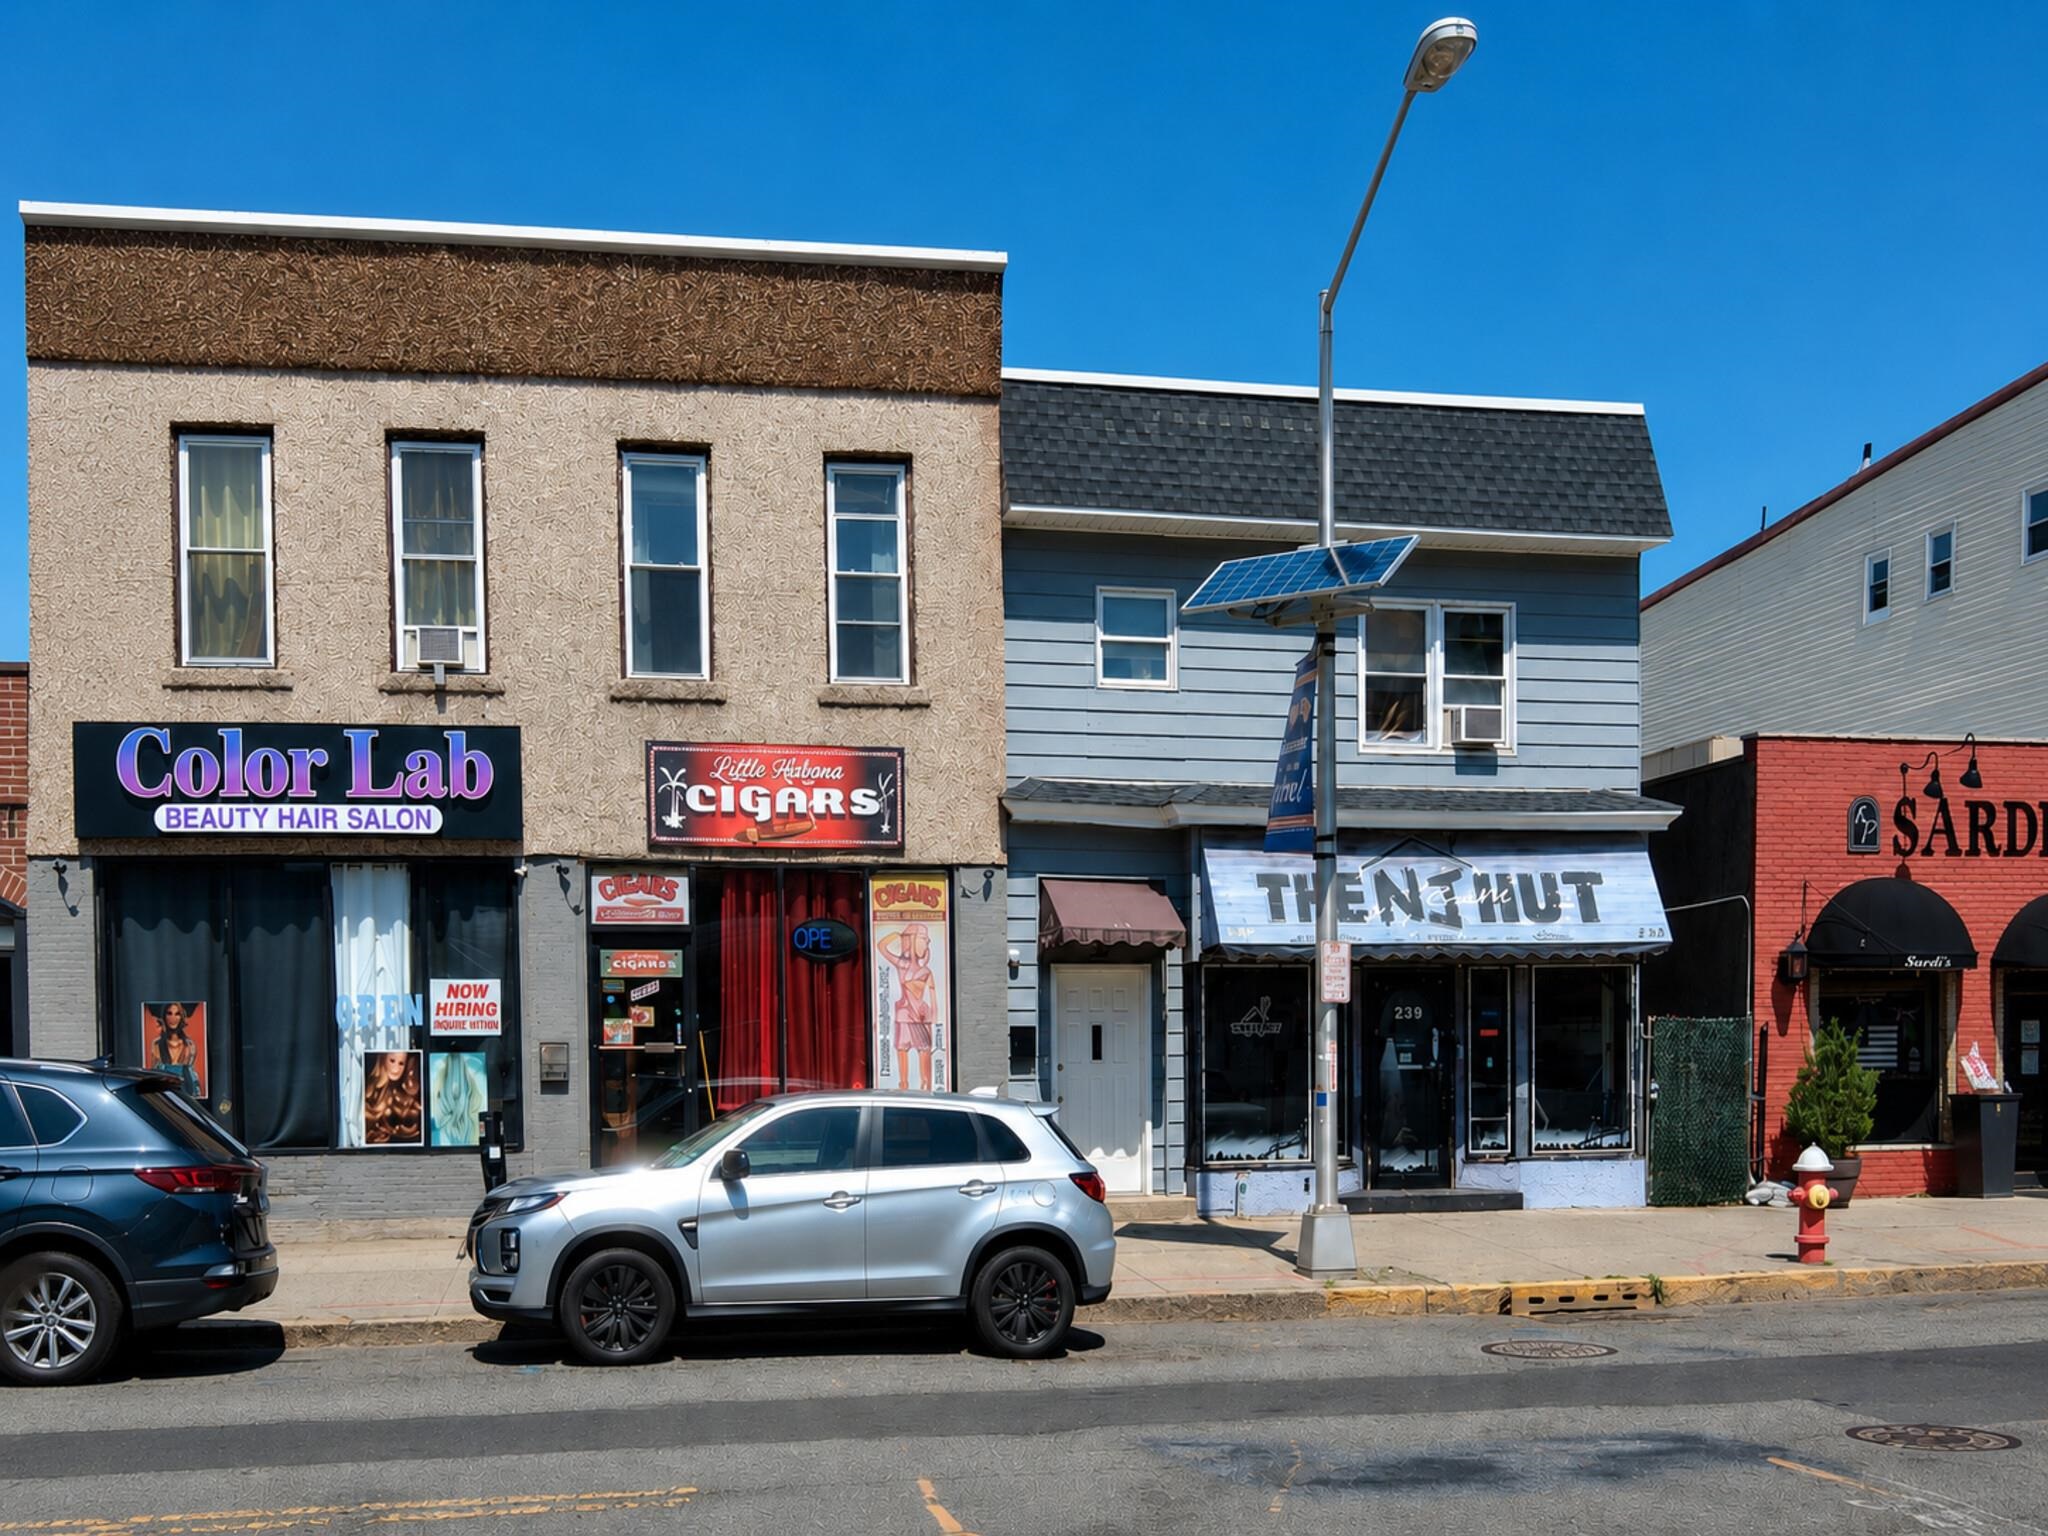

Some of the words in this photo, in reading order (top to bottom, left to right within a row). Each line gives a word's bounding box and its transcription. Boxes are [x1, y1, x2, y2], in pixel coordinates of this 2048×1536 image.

[116, 727, 329, 798] Color
[343, 729, 494, 799] Lab
[709, 755, 767, 784] Little
[685, 784, 881, 822] CIGARS
[165, 807, 269, 830] BEAUTY
[277, 808, 339, 830] HAIR
[347, 808, 433, 831] SALON
[1905, 955, 1951, 968] Sardi's
[446, 983, 489, 999] NOW
[336, 993, 423, 1030] OPEN
[435, 1002, 497, 1017] HIRING
[1394, 1006, 1423, 1020] 239
